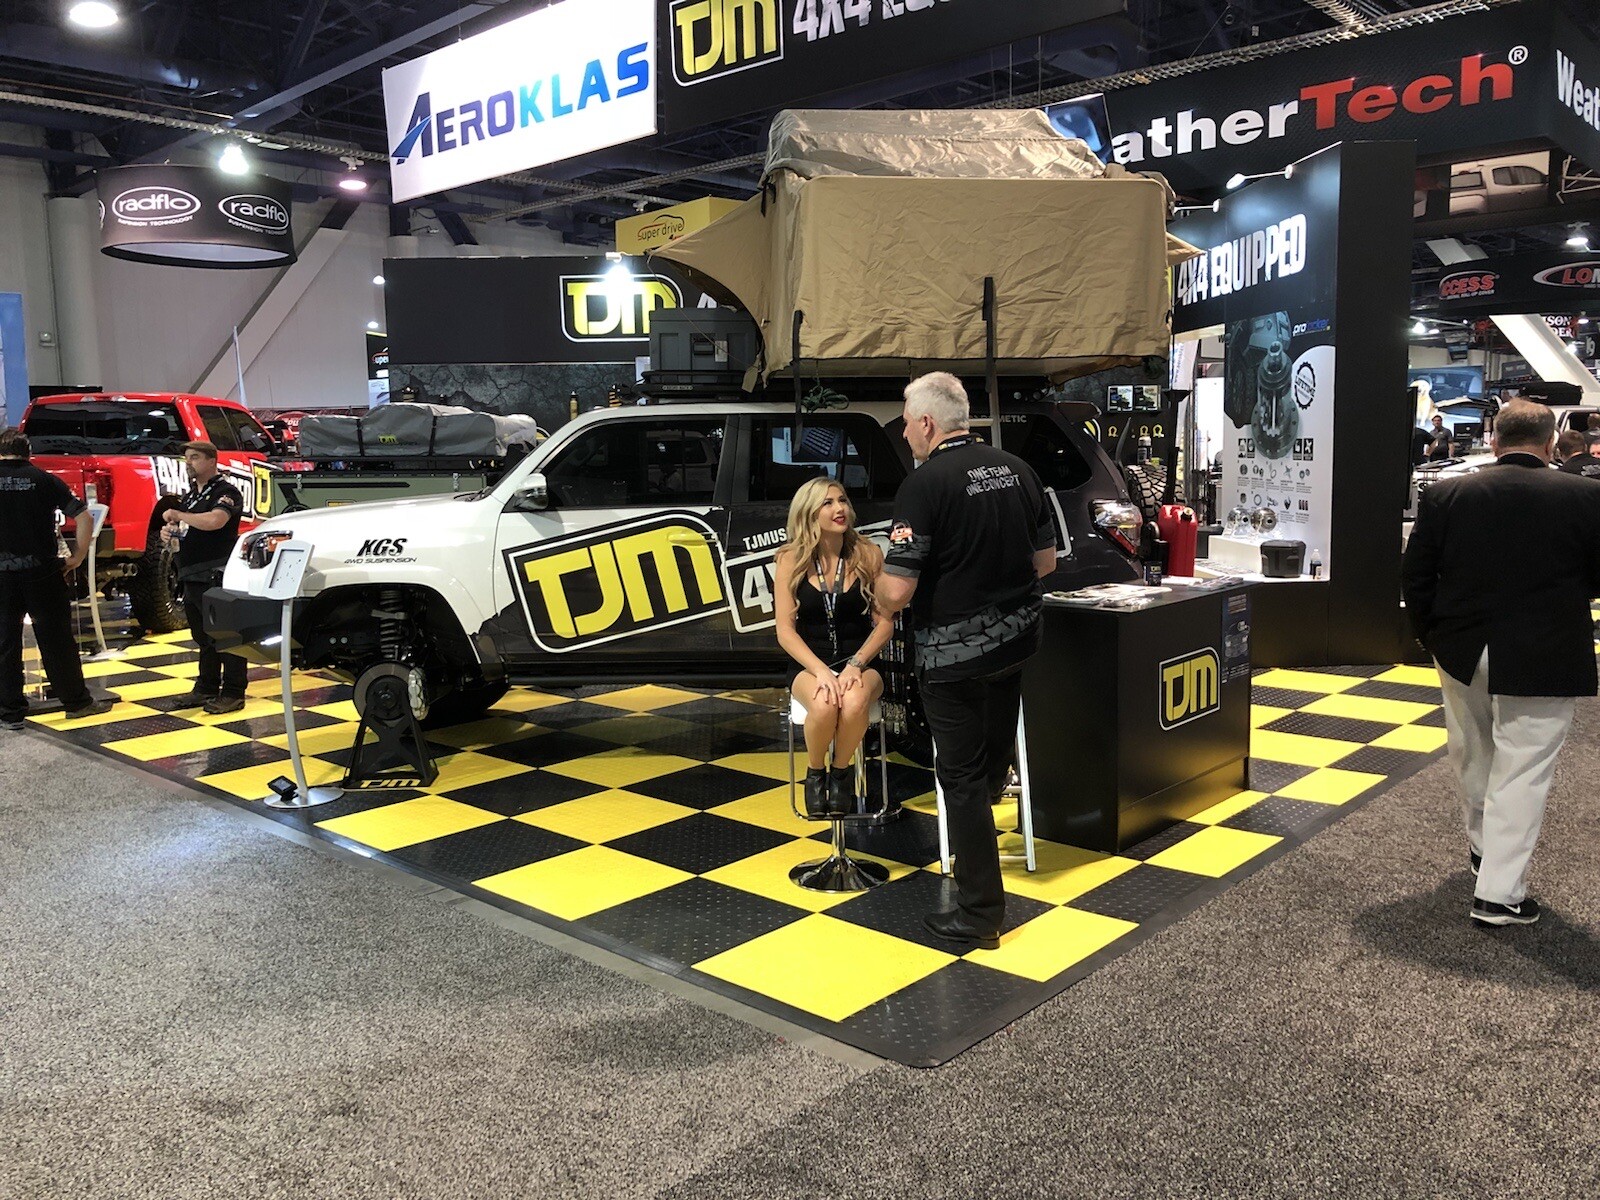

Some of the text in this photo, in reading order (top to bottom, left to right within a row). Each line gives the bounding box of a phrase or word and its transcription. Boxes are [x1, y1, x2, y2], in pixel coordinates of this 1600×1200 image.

[391, 42, 649, 165] AEROKLAS
[119, 194, 191, 213] radflo
[231, 201, 287, 224] radflo
[661, 221, 686, 236] drive
[1210, 213, 1306, 298] EQUIPPED
[988, 465, 1012, 478] TEAM
[356, 538, 408, 557] KGS
[524, 525, 723, 639] TJM
[1163, 654, 1217, 721] TJM
